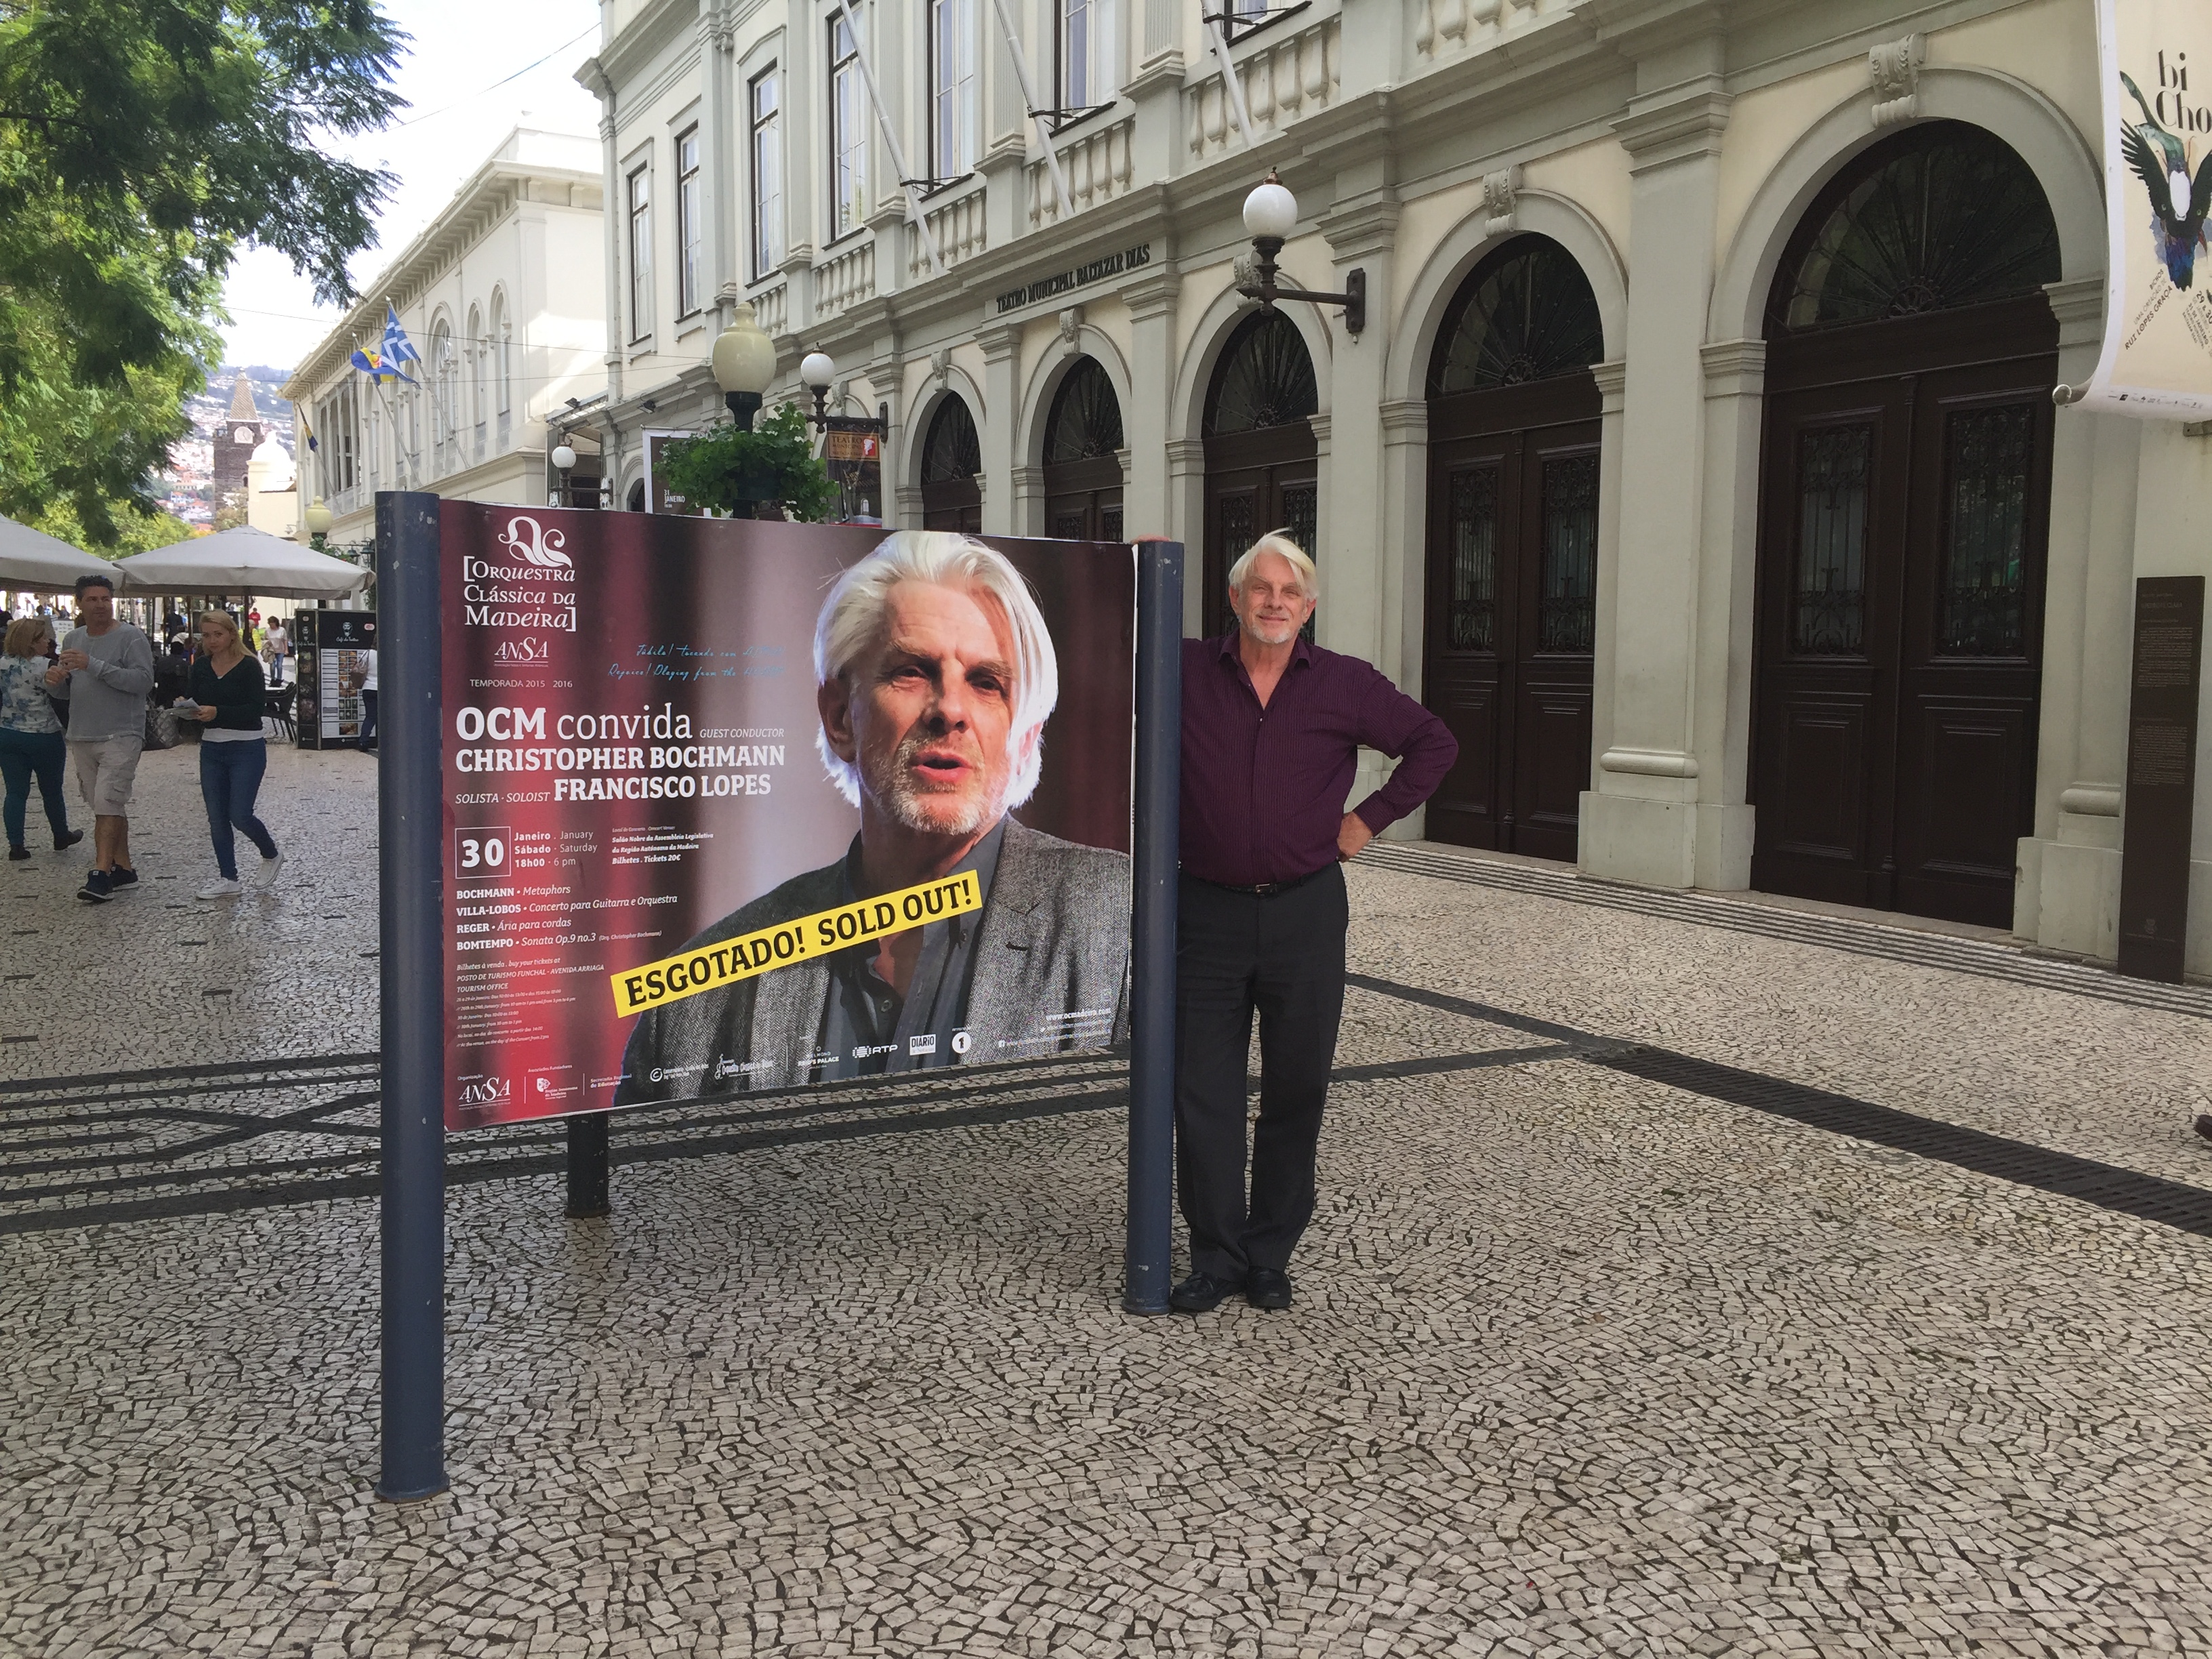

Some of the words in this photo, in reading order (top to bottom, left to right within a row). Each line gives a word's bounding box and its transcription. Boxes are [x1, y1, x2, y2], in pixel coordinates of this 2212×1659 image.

[2158, 49, 2187, 91] bi
[996, 288, 1027, 313] TEATRO
[1028, 272, 1075, 303] MUNICIPAL
[1076, 254, 1124, 287] BALTAZAR
[1126, 243, 1150, 269] DIAS
[2150, 268, 2164, 290] BICHOS
[2196, 290, 2205, 304] 29
[2125, 333, 2137, 350] RUI
[2136, 310, 2154, 335] LOPES
[832, 436, 862, 444] TEATRO
[664, 495, 686, 504] JANEIRO
[494, 636, 549, 661] ANSA
[721, 667, 736, 676] the
[470, 679, 523, 688] TEMPORADA
[525, 680, 546, 688] 2015
[456, 707, 546, 740] OCM
[557, 702, 693, 740] convida
[699, 729, 728, 739] GUEST
[730, 728, 784, 738] CONDUCTOR
[455, 746, 644, 772] CHRISTOPHER
[649, 745, 785, 769] BOCHMANN
[455, 793, 499, 804] SOLISTA
[506, 792, 550, 802] SOLOIST
[554, 775, 696, 802] FRANCISCO
[701, 773, 771, 797] LOPES
[514, 832, 551, 841] Janeiro
[560, 831, 594, 841] January
[654, 833, 684, 841] Assembleia
[685, 832, 714, 840] Legislativa
[462, 838, 504, 868] 30
[514, 844, 551, 855] Sábado
[560, 843, 598, 854] Saturday
[620, 846, 640, 854] Região
[514, 858, 545, 868] 18h00
[554, 857, 560, 867] 6
[562, 859, 576, 867] pm
[612, 856, 640, 865] Bilhetes
[644, 855, 667, 863] Tickets
[668, 854, 681, 862] 20€
[456, 888, 514, 899] BOCHMANN
[523, 884, 571, 897] Metaphors
[456, 904, 521, 916] VILLA-LOBOS
[529, 902, 569, 912] Concerto
[570, 901, 591, 912] para
[592, 898, 629, 908] Guitarra
[637, 895, 678, 907] Orquestra
[456, 923, 489, 934] REGER
[497, 920, 517, 931] Ária
[518, 921, 540, 932] para
[541, 917, 571, 928] cordas
[456, 938, 513, 951] BOMTEMPO
[521, 937, 553, 946] Sonata
[555, 933, 576, 946] Op.9
[577, 933, 596, 943] no.3
[625, 926, 804, 1007] ESGOTADO!
[819, 902, 896, 946] SOLD
[903, 879, 973, 919] OUT!
[456, 962, 480, 970] Bilhetes
[487, 961, 505, 969] venda
[508, 960, 519, 968] buy
[518, 960, 533, 968] your
[488, 971, 516, 979] TURISMO
[517, 969, 546, 977] FUNCHAL
[550, 966, 577, 975] AVENIDA
[457, 984, 486, 993] TOURISM
[873, 1044, 898, 1054] RTP
[958, 1036, 965, 1049] 1
[817, 1056, 840, 1065] PALACE
[459, 1077, 511, 1103] ANSA
